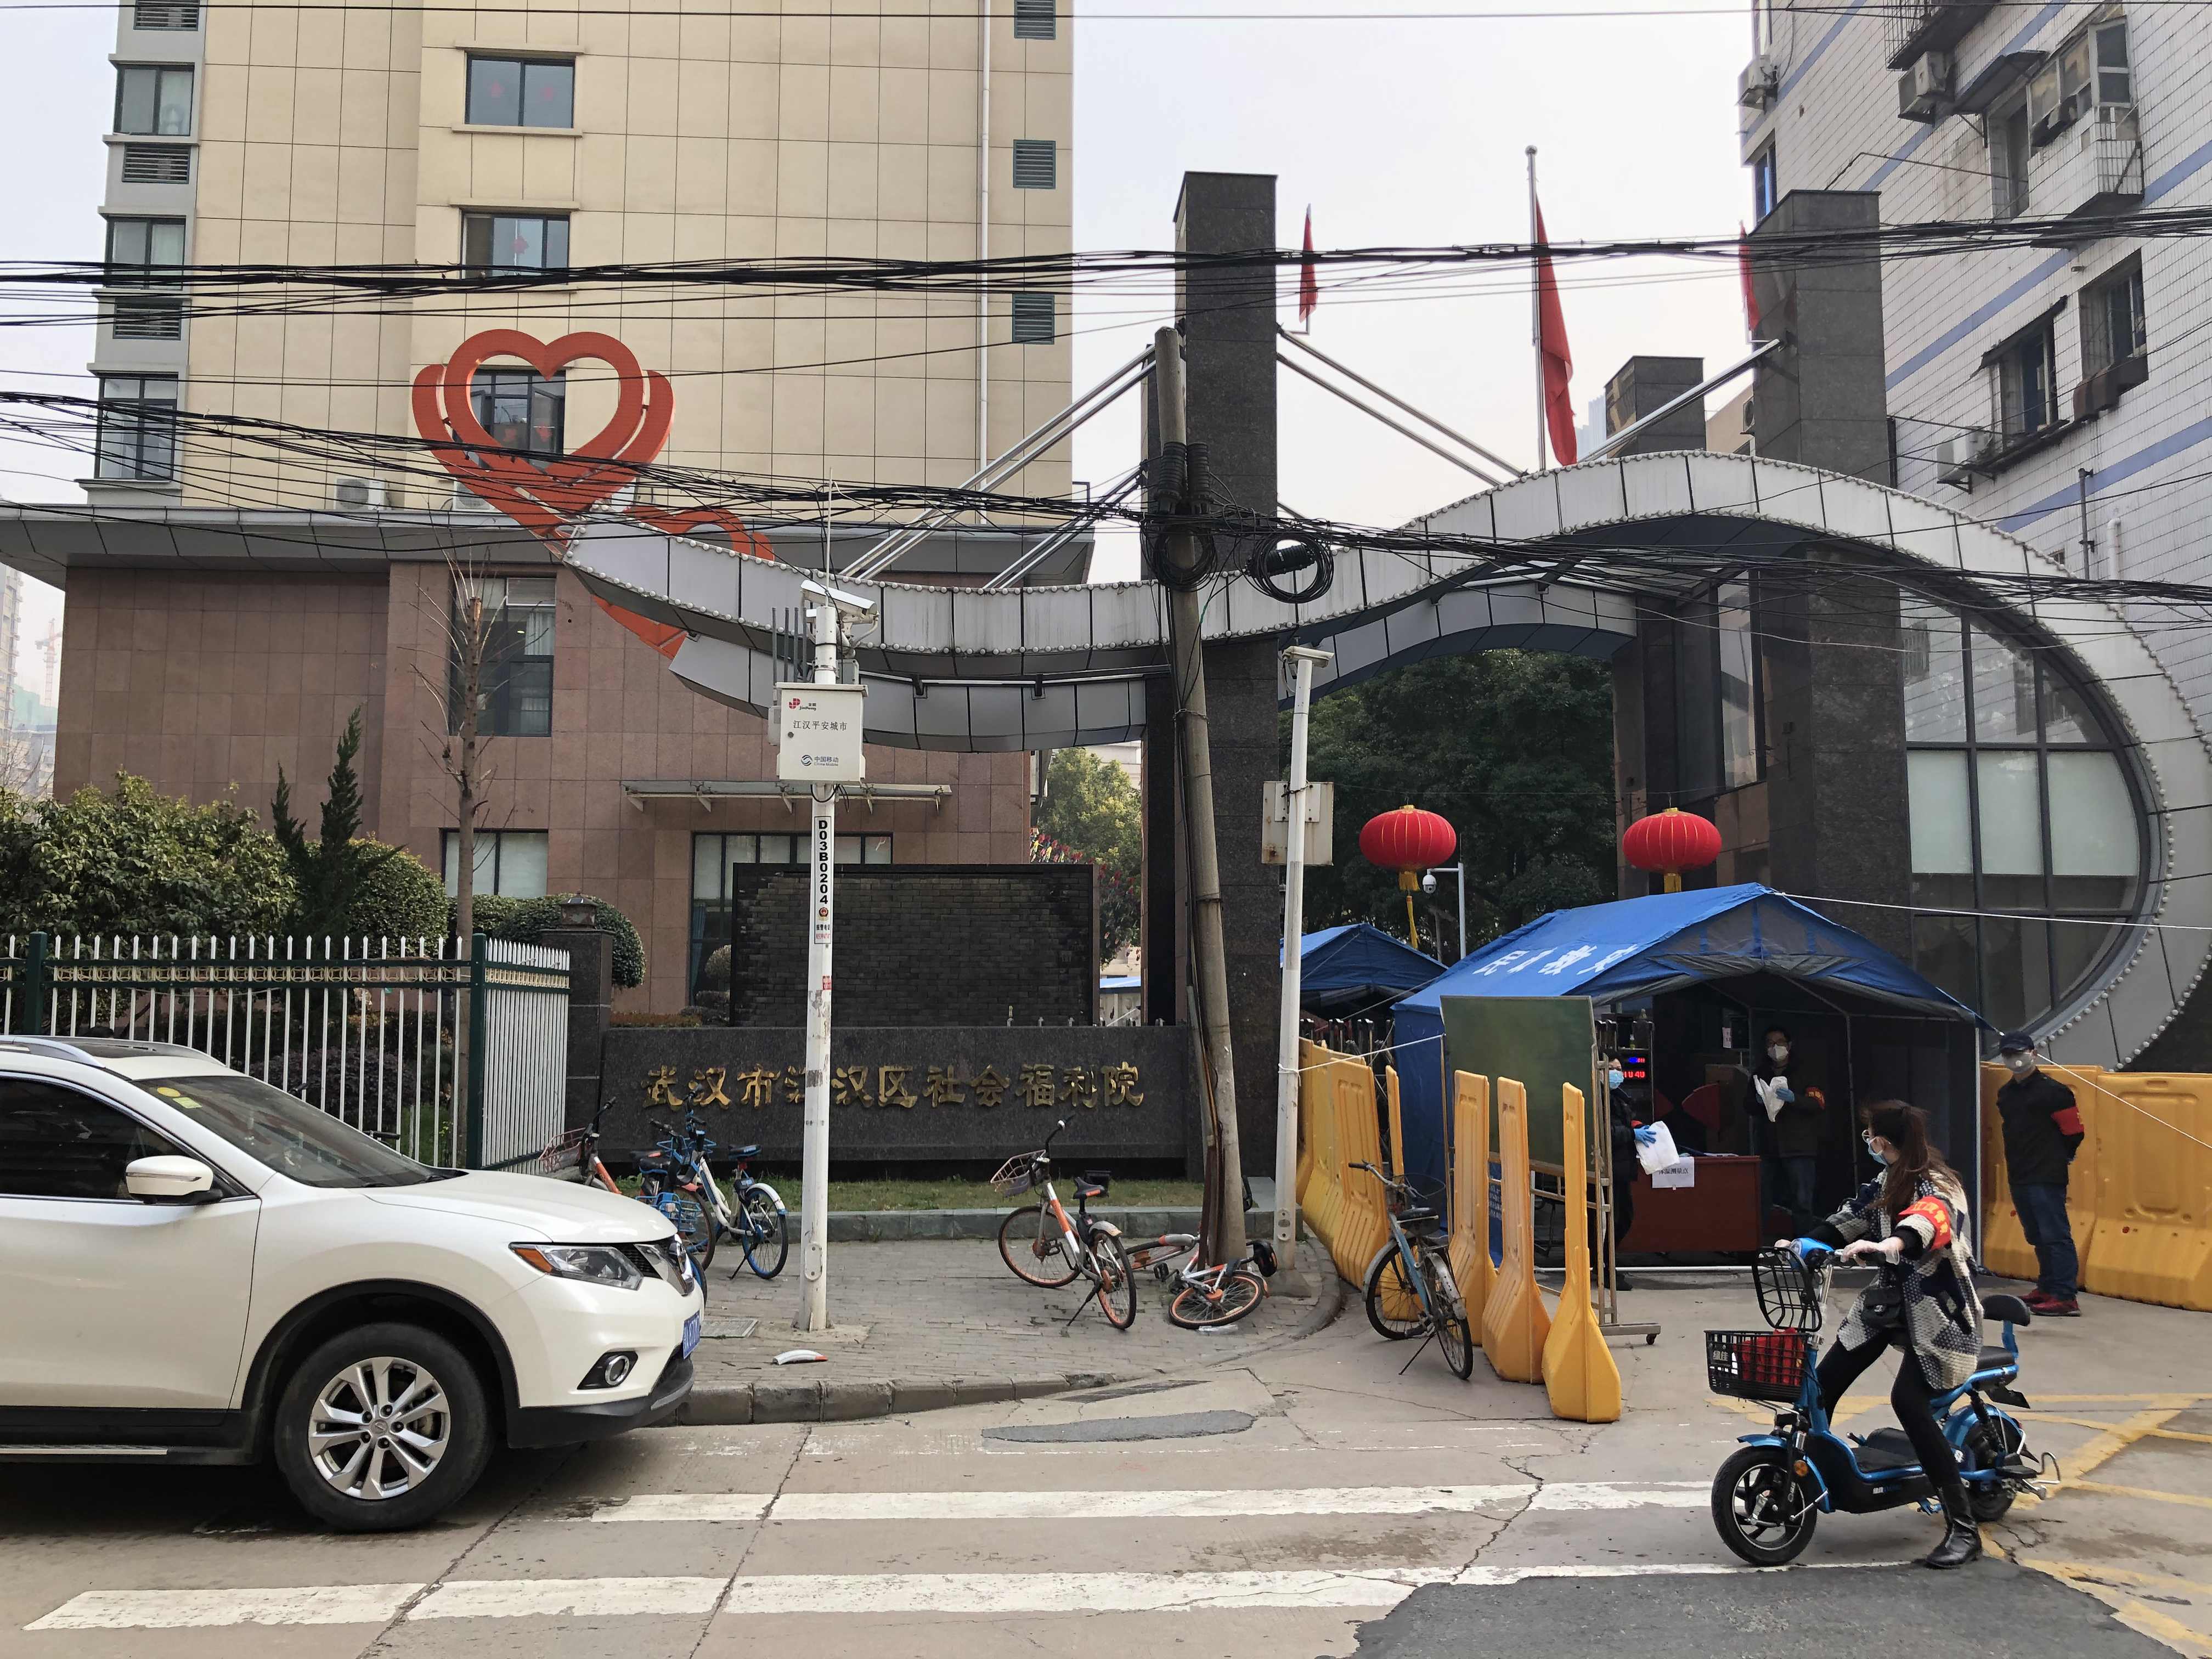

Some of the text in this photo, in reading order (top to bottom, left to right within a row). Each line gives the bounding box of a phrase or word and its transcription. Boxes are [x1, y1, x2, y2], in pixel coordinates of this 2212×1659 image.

[793, 720, 847, 731] 江汉平安城市
[818, 820, 828, 904] D03B0204
